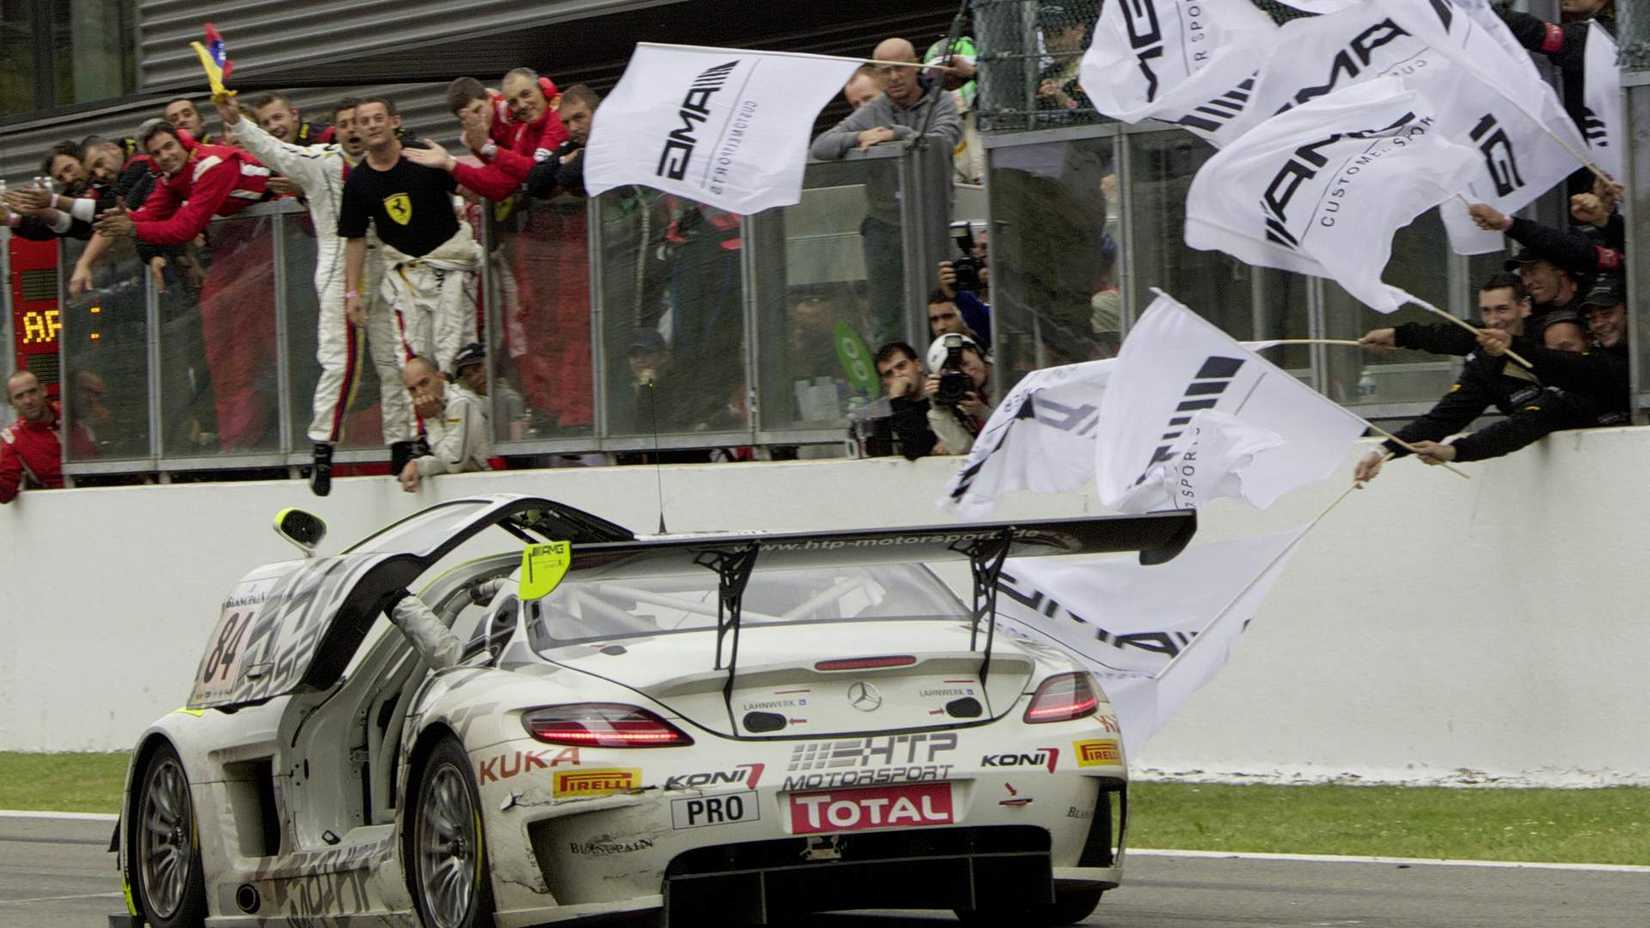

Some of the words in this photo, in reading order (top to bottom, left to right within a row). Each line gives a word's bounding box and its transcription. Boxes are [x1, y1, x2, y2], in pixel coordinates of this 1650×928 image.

[203, 611, 254, 684] 84
[861, 732, 958, 767] HTP
[981, 753, 1046, 768] KONI
[479, 747, 580, 786] KUKA
[664, 769, 748, 791] KONI
[782, 764, 954, 793] MOTORSPORT
[559, 772, 633, 793] PIRELLI
[686, 795, 744, 825] PRO
[796, 795, 950, 829] TOTAL
